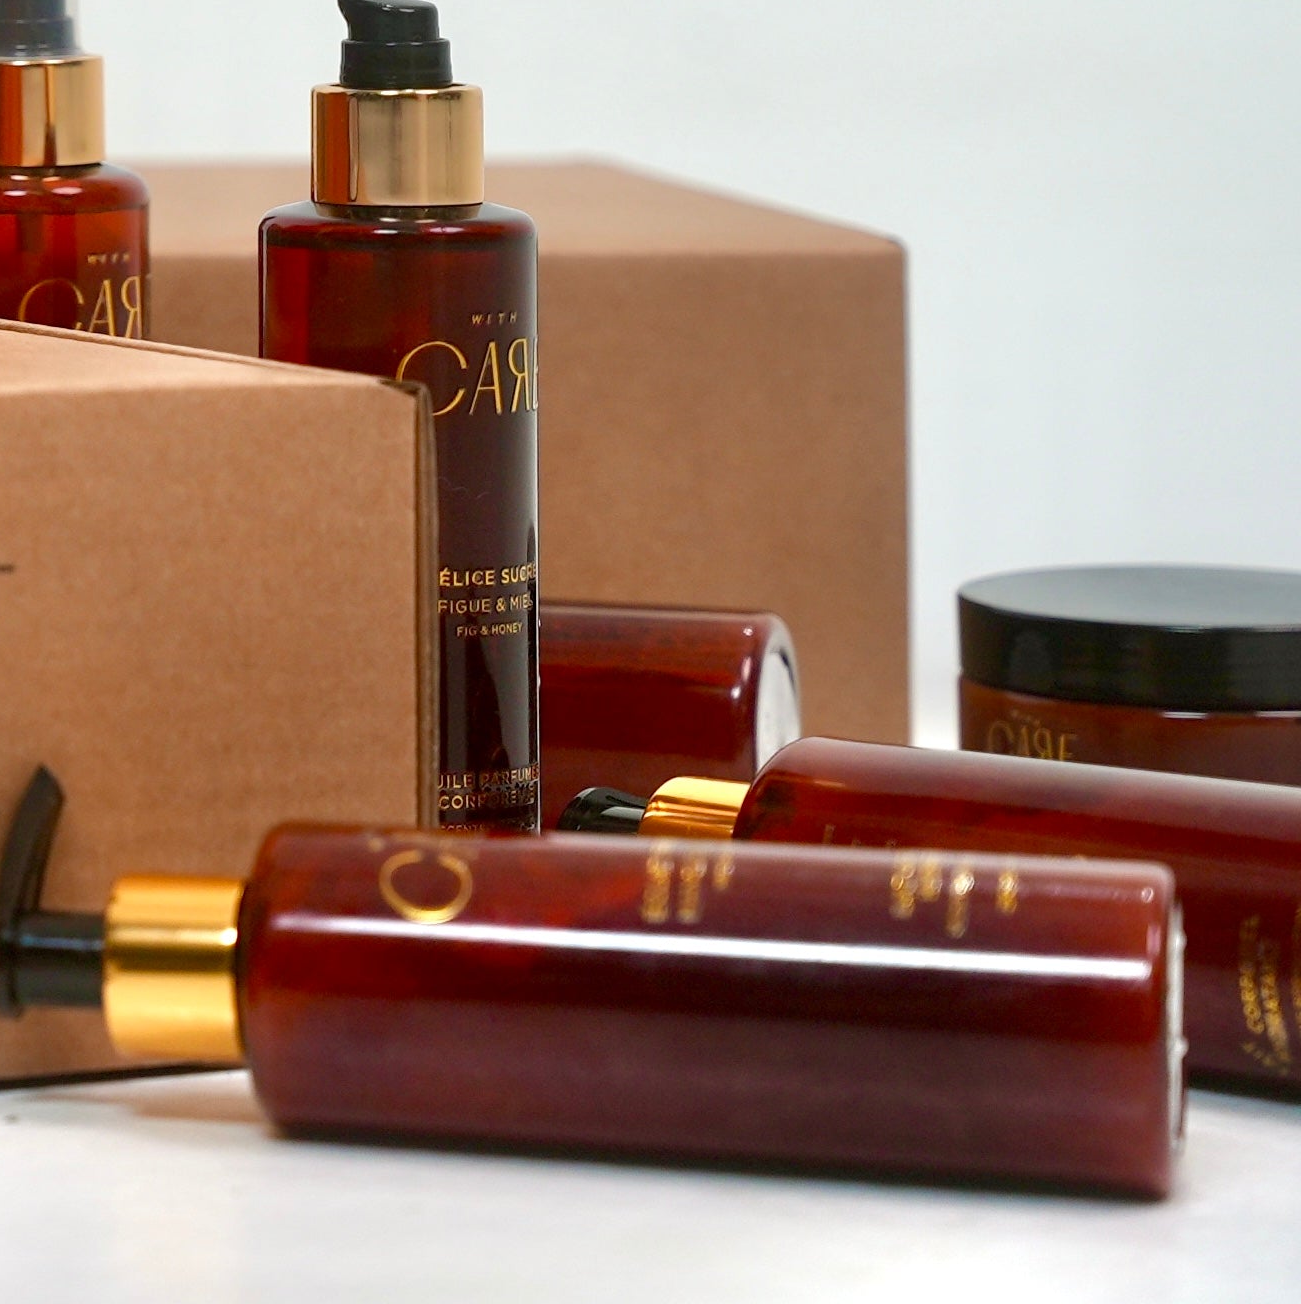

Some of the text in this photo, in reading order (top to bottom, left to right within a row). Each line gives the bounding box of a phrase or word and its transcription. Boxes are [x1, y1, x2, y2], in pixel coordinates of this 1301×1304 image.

[19, 275, 144, 339] CAR
[471, 311, 518, 326] WITH
[438, 565, 496, 588] ÉLICE
[437, 597, 491, 615] FIGUE
[495, 596, 506, 613] &
[456, 622, 524, 638] FIG & HONEY
[437, 773, 476, 790] UILE
